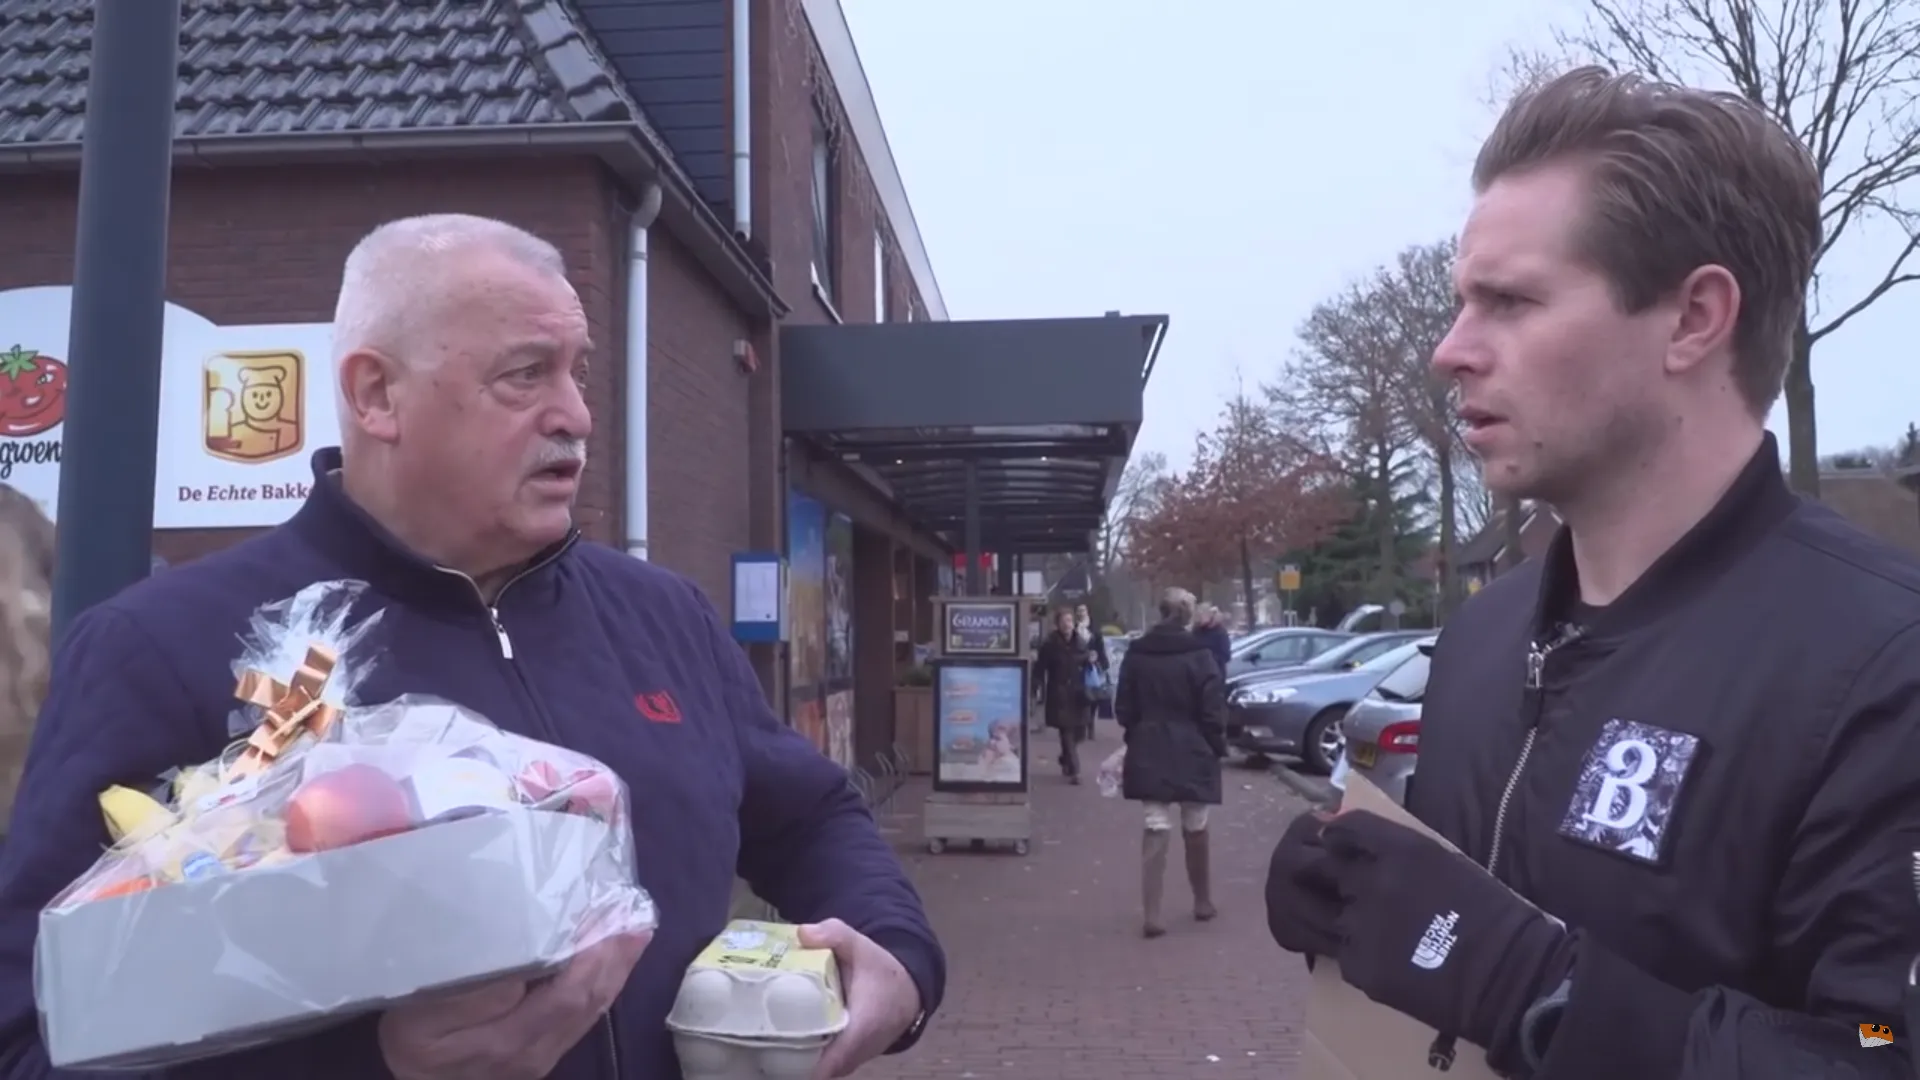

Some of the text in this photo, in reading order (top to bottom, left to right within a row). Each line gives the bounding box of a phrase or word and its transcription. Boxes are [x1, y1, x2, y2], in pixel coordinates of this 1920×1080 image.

[178, 485, 202, 502] De
[207, 484, 257, 501] Echte
[952, 612, 1009, 628] GRANOLA
[1419, 914, 1445, 950] FACE
[1430, 910, 1460, 952] NORTH
[1438, 935, 1458, 958] THE
